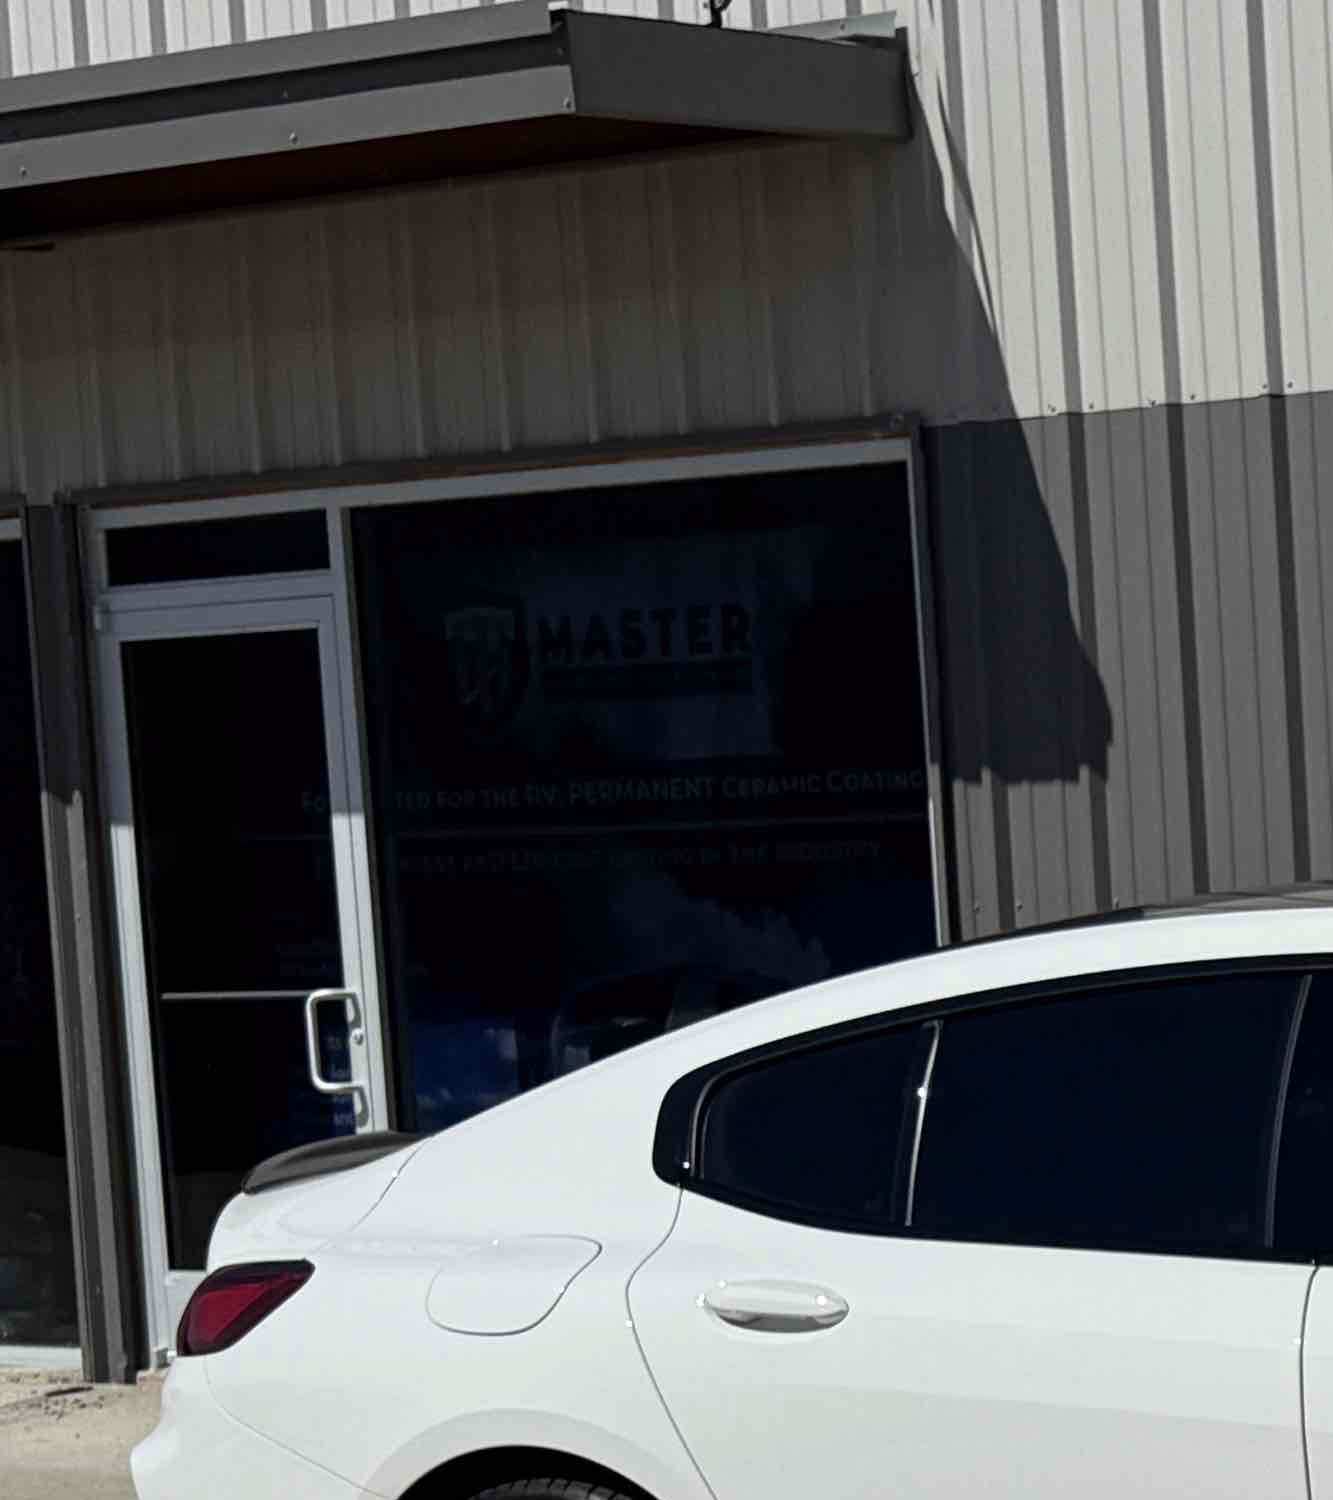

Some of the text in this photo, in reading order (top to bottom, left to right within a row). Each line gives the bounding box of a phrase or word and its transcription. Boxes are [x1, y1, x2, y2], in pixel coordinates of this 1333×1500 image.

[538, 603, 750, 663] MASTER
[568, 775, 713, 803] PERMANENT
[721, 773, 820, 799] CERAMIC
